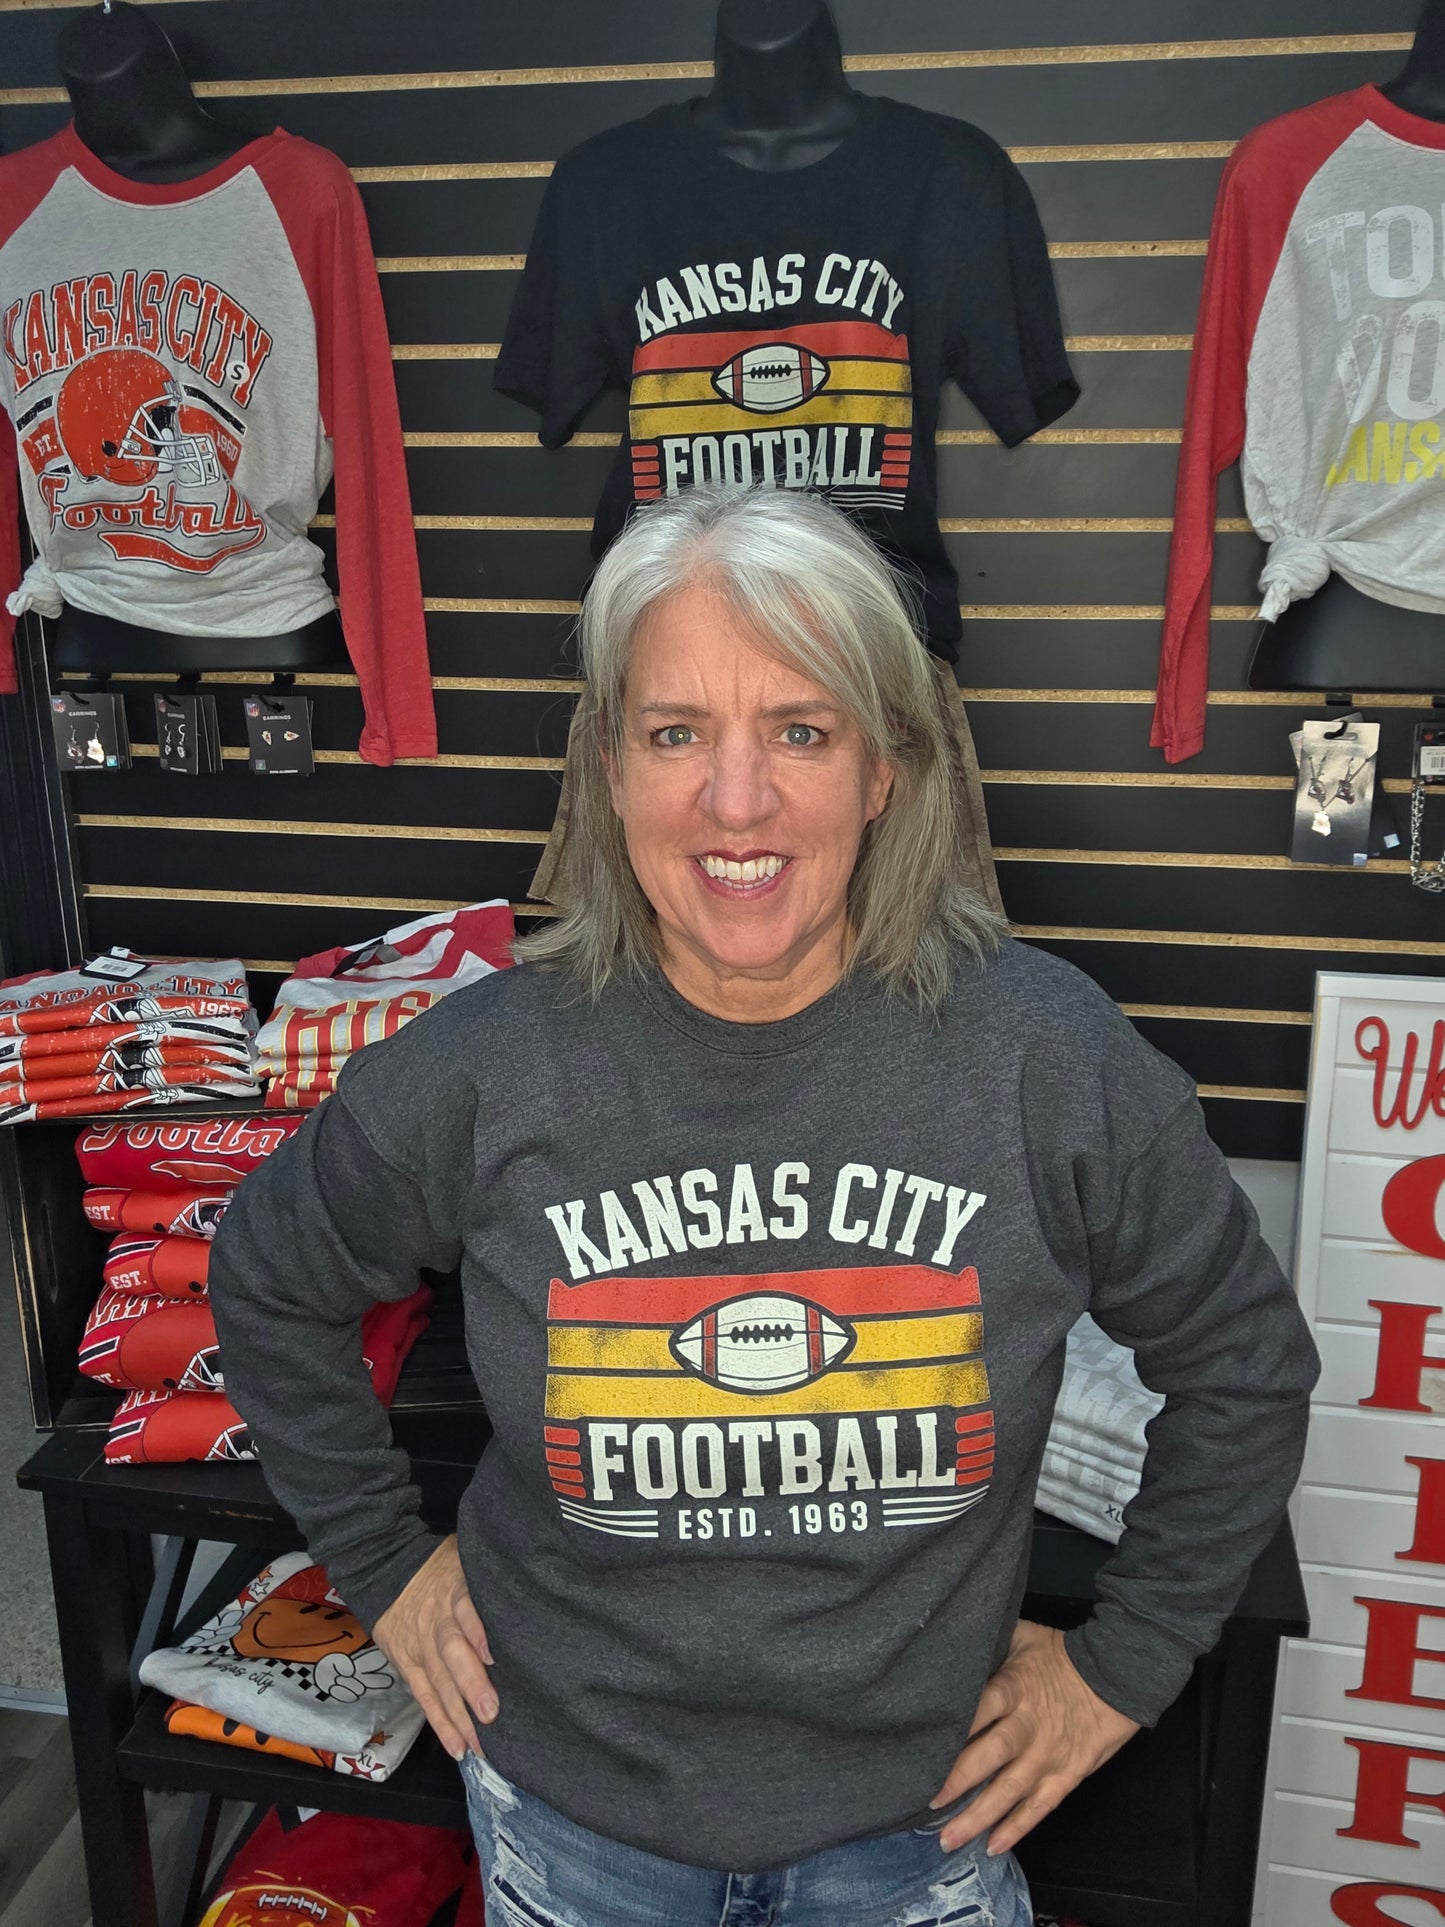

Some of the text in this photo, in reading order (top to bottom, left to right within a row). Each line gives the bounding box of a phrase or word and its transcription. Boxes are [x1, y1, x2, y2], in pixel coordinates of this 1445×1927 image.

[635, 253, 905, 342] KANSAS CITY
[166, 274, 273, 409] CITY
[230, 364, 245, 381] S
[216, 430, 239, 462] 1960
[663, 427, 882, 497] FOOTBALL
[39, 472, 264, 536] Football
[84, 1205, 115, 1221] EST.
[544, 1162, 987, 1280] KANSAS CITY
[110, 1271, 147, 1290] EST.
[588, 1413, 956, 1500] FOOTBALL
[678, 1501, 868, 1539] ESTD. 1963
[1104, 1504, 1122, 1524] XL
[249, 1670, 275, 1695] city
[358, 1752, 373, 1768] XL
